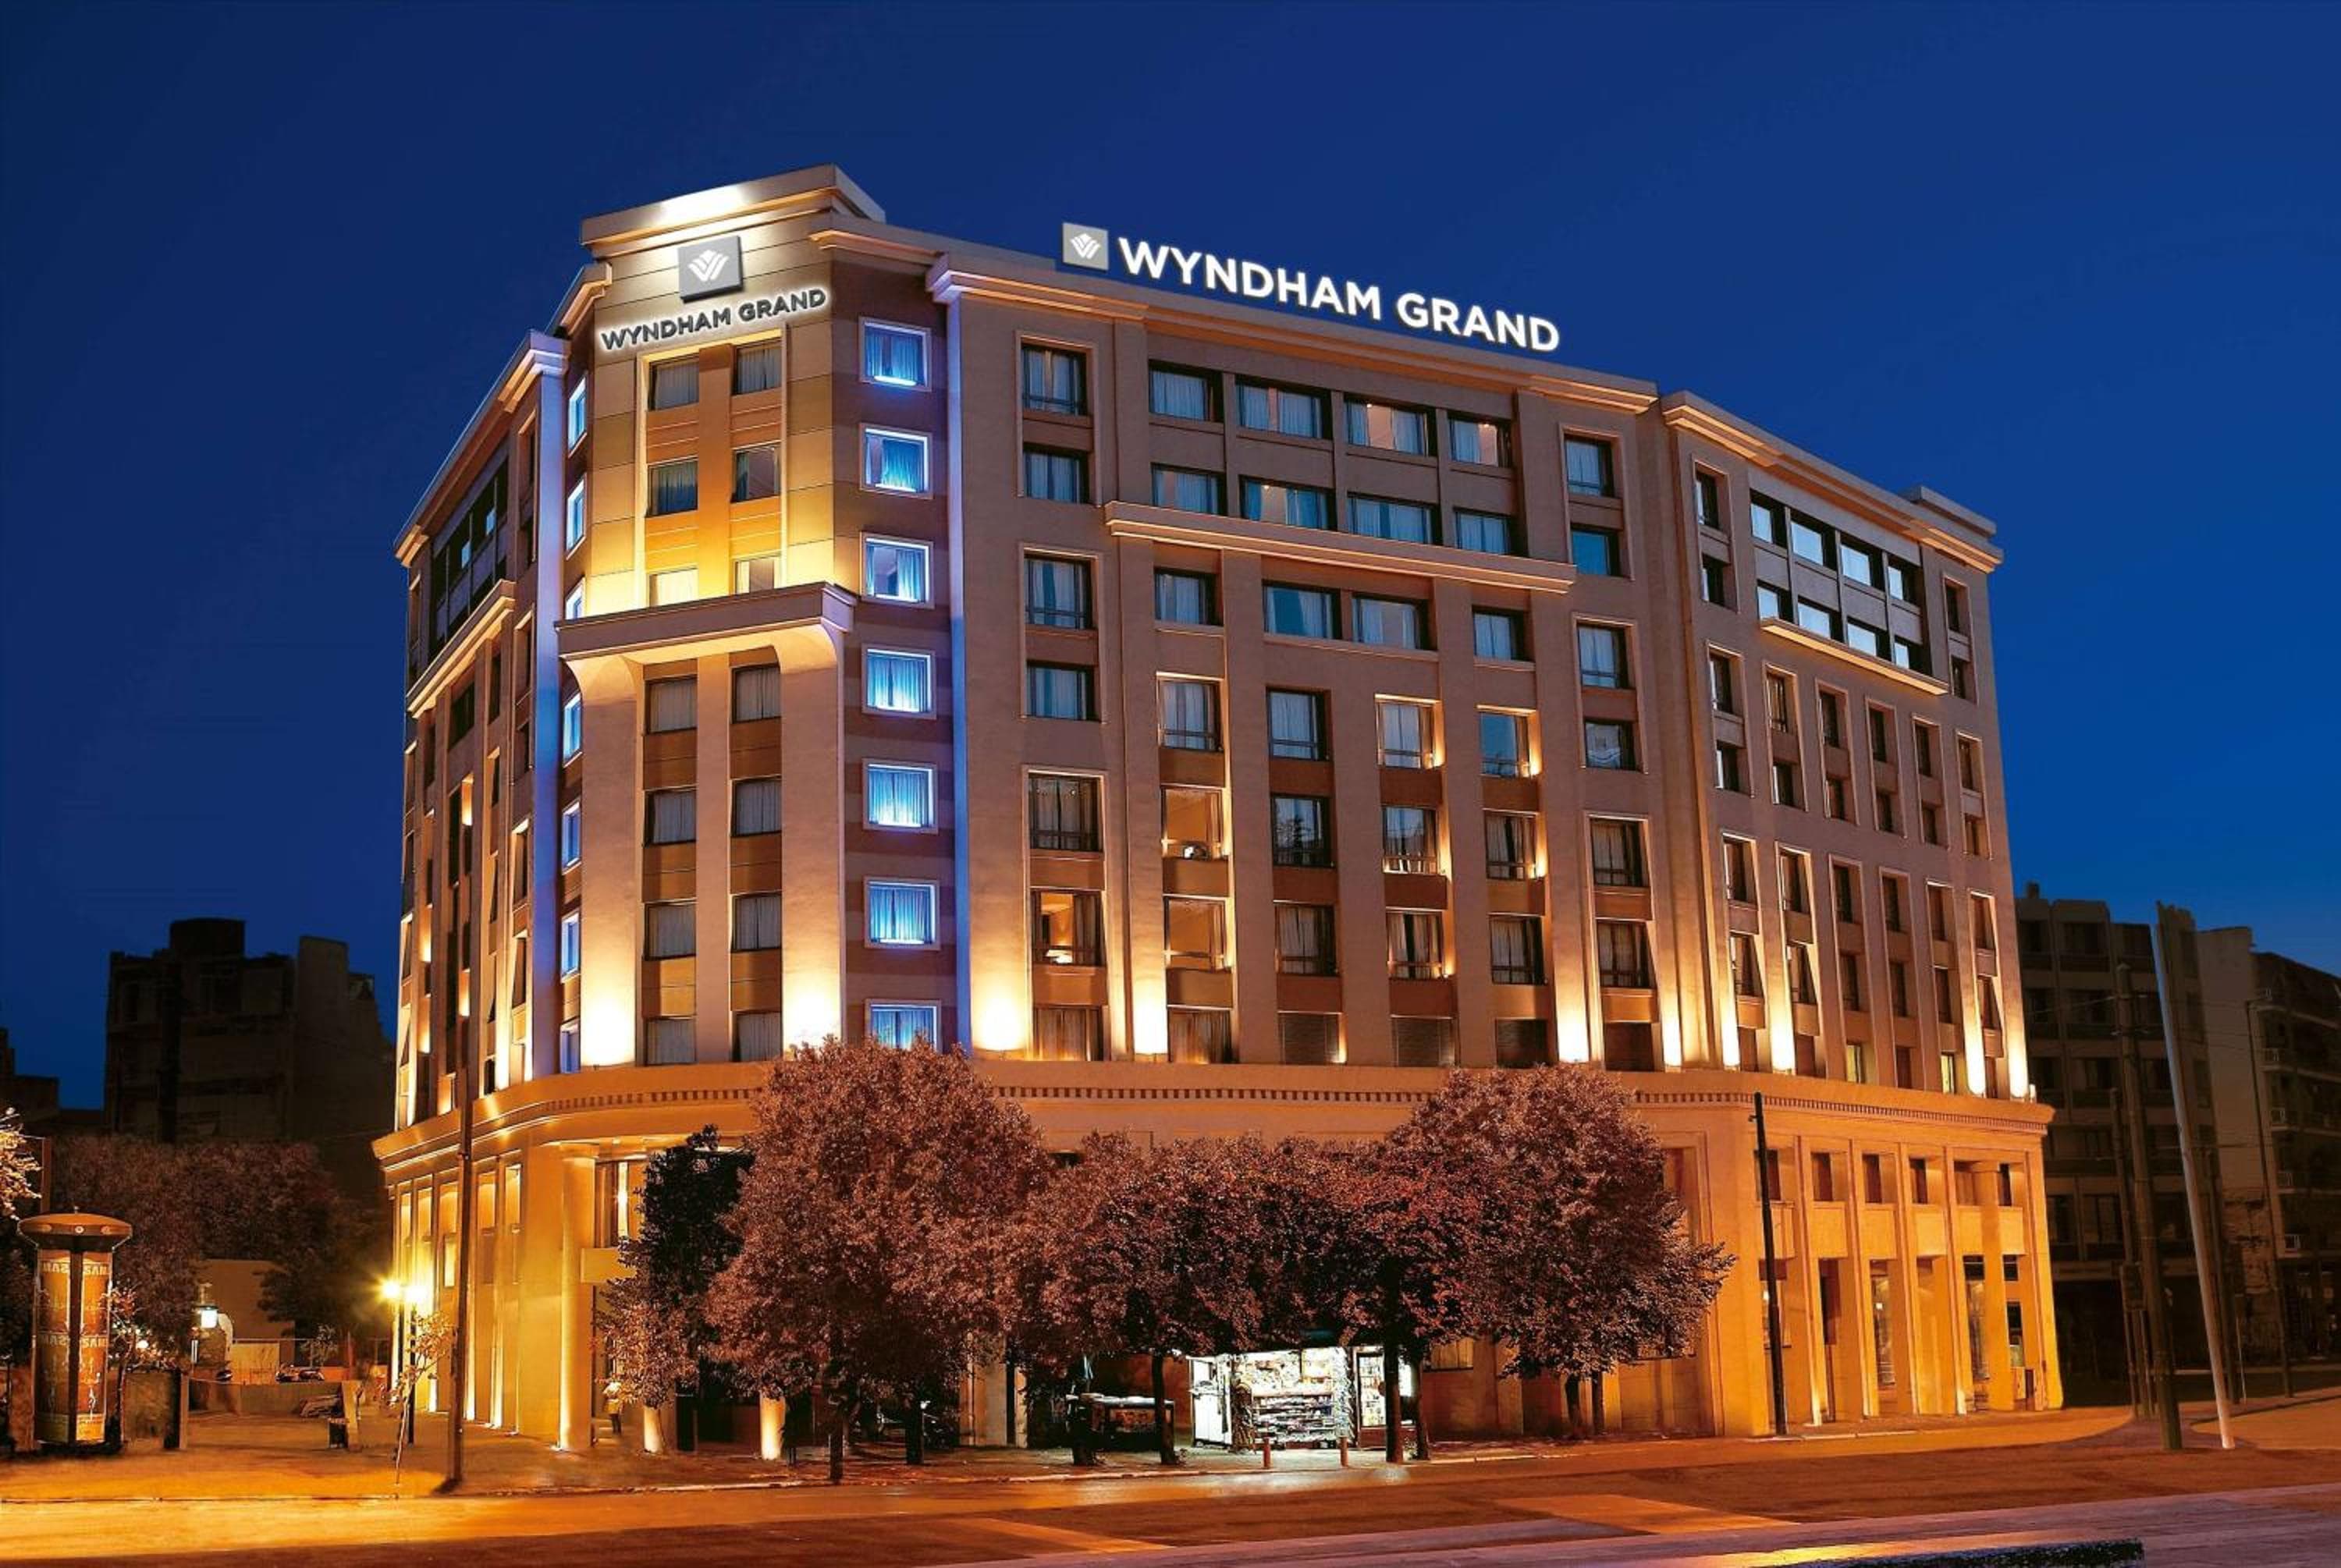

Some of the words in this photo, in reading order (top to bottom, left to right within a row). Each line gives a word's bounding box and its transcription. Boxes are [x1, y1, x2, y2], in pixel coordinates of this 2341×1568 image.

[601, 307, 731, 350] WYNDHAM
[738, 289, 826, 322] GRAND
[1118, 236, 1380, 321] WYNDHAM
[1397, 292, 1559, 352] GRAND
